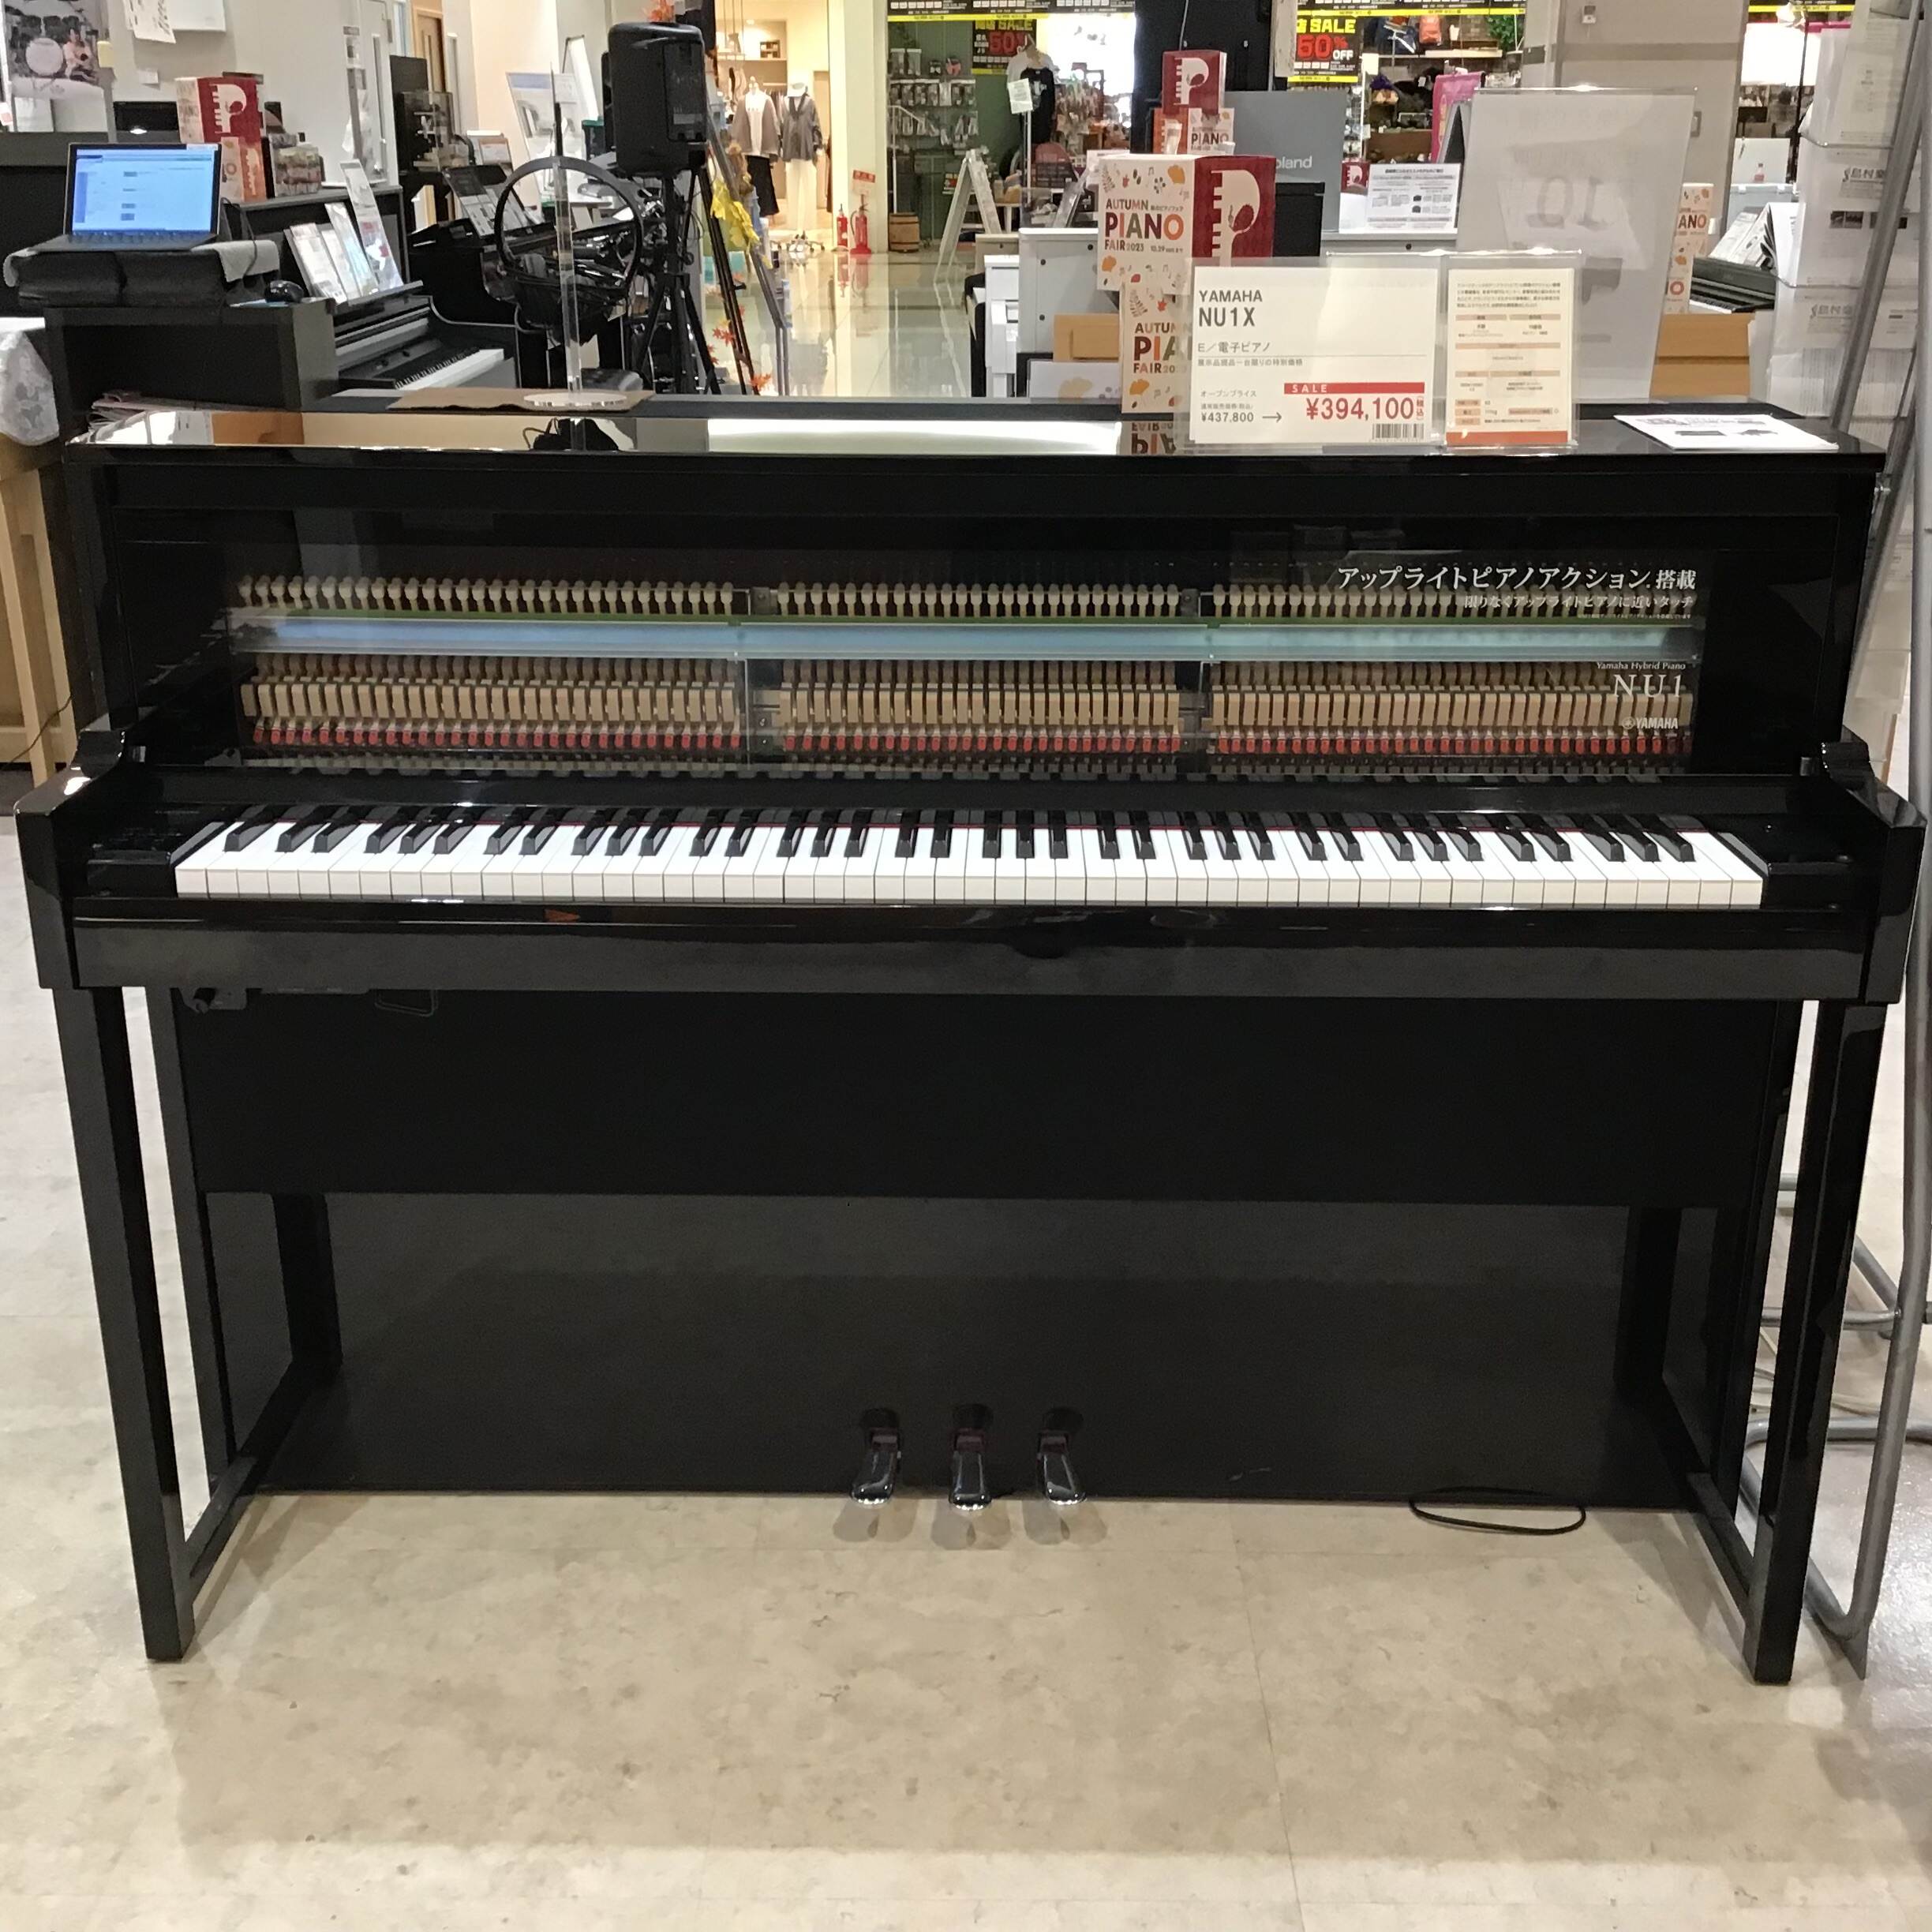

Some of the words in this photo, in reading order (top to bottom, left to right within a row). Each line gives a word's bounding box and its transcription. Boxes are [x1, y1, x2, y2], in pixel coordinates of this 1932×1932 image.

[1309, 18, 1356, 33] SALE
[1332, 49, 1354, 61] OFF
[1191, 132, 1229, 144] PIANO
[1106, 198, 1149, 211] AUTUMN
[1105, 212, 1185, 241] PIANO
[1678, 214, 1707, 229] ANO
[1105, 239, 1125, 252] FAIR
[1126, 242, 1144, 253] 2023
[1199, 290, 1264, 302] YAMAHA
[1198, 306, 1256, 327] NU1X
[1133, 362, 1163, 374] FAIR
[1291, 384, 1327, 393] SALE
[1305, 397, 1414, 421] ¥394,100
[1200, 411, 1255, 423] ¥437,800
[1597, 661, 1629, 670] Yamaha
[1631, 661, 1661, 672] Hybrid
[1612, 674, 1682, 698] NU1
[1634, 717, 1679, 730] YAMAHA
